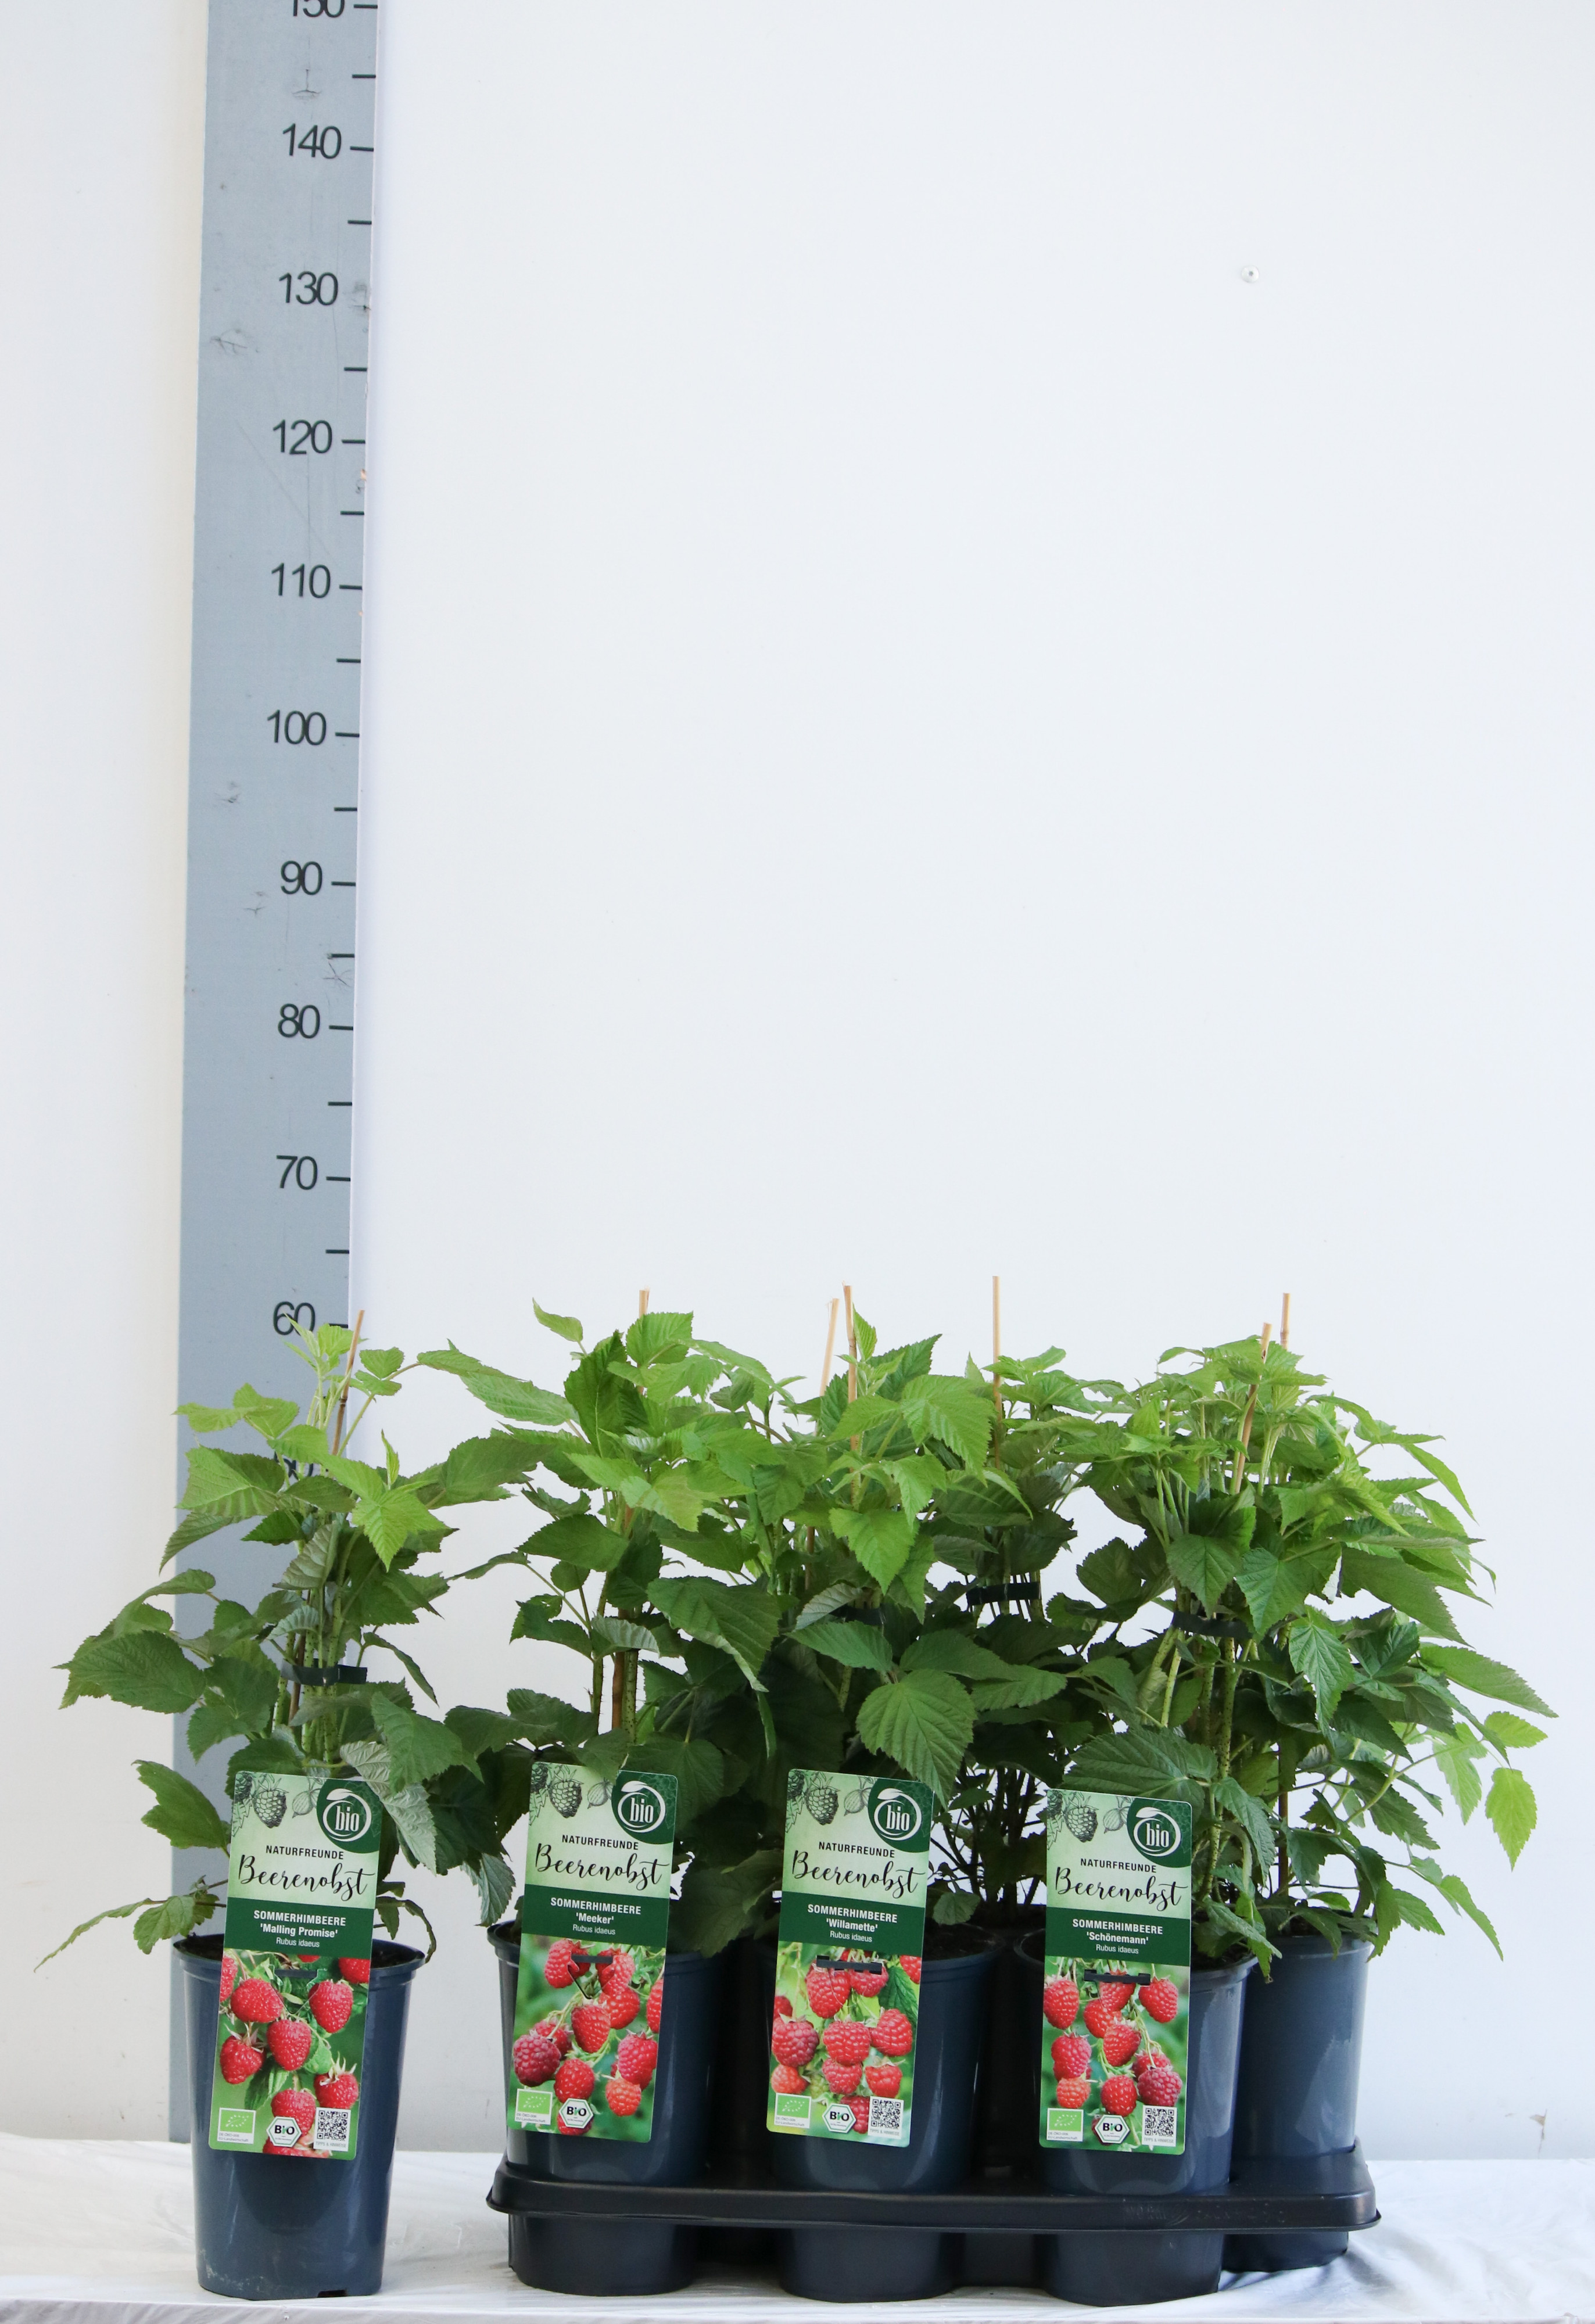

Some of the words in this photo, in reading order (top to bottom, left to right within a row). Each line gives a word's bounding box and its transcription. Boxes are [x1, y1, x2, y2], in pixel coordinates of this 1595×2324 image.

[282, 123, 342, 159] 140
[279, 271, 338, 306] 130
[273, 419, 332, 455] 120
[271, 563, 331, 598] 110
[267, 709, 327, 746] 100
[281, 860, 323, 896] 90
[278, 1003, 321, 1039] 80
[276, 1155, 318, 1190] 70
[273, 1301, 315, 1336] 60
[335, 1806, 359, 1831] bio
[630, 1797, 654, 1823] bio
[886, 1805, 910, 1831] bio
[562, 1835, 639, 1850] NATURFREUNDE
[1146, 1823, 1170, 1848] bio
[266, 1845, 344, 1859] NATURFREUNDE
[819, 1842, 895, 1858] NATURFREUNDE
[238, 1855, 375, 1901] Beerenobst
[535, 1843, 669, 1890] Beerenobst
[793, 1850, 925, 1899] Beerenobst
[1081, 1859, 1156, 1873] NATURFREUNDE
[1055, 1867, 1188, 1911] Beerenobst
[253, 1910, 346, 1926] SOMMERHIMBEERE
[551, 1897, 641, 1914] SOMMERHIMBEERE
[576, 1912, 614, 1924] 'Meeker'
[808, 1904, 897, 1923] SOMMERHIMBEERE
[260, 1923, 296, 1936] 'Malling
[298, 1926, 338, 1938] Promise'
[573, 1924, 593, 1933] Rubus
[594, 1926, 615, 1935] idaeus
[826, 1918, 878, 1932] 'Willamette'
[830, 1931, 850, 1939] Rubus
[852, 1934, 872, 1942] idaeus
[1073, 1918, 1163, 1935] SOMMERHIMBEERE
[276, 1937, 296, 1946] Rubus
[299, 1939, 320, 1948] idaeus
[1087, 1931, 1149, 1945] 'Schönemann'
[1096, 1944, 1116, 1952] Rubus
[1118, 1946, 1139, 1954] idaeus
